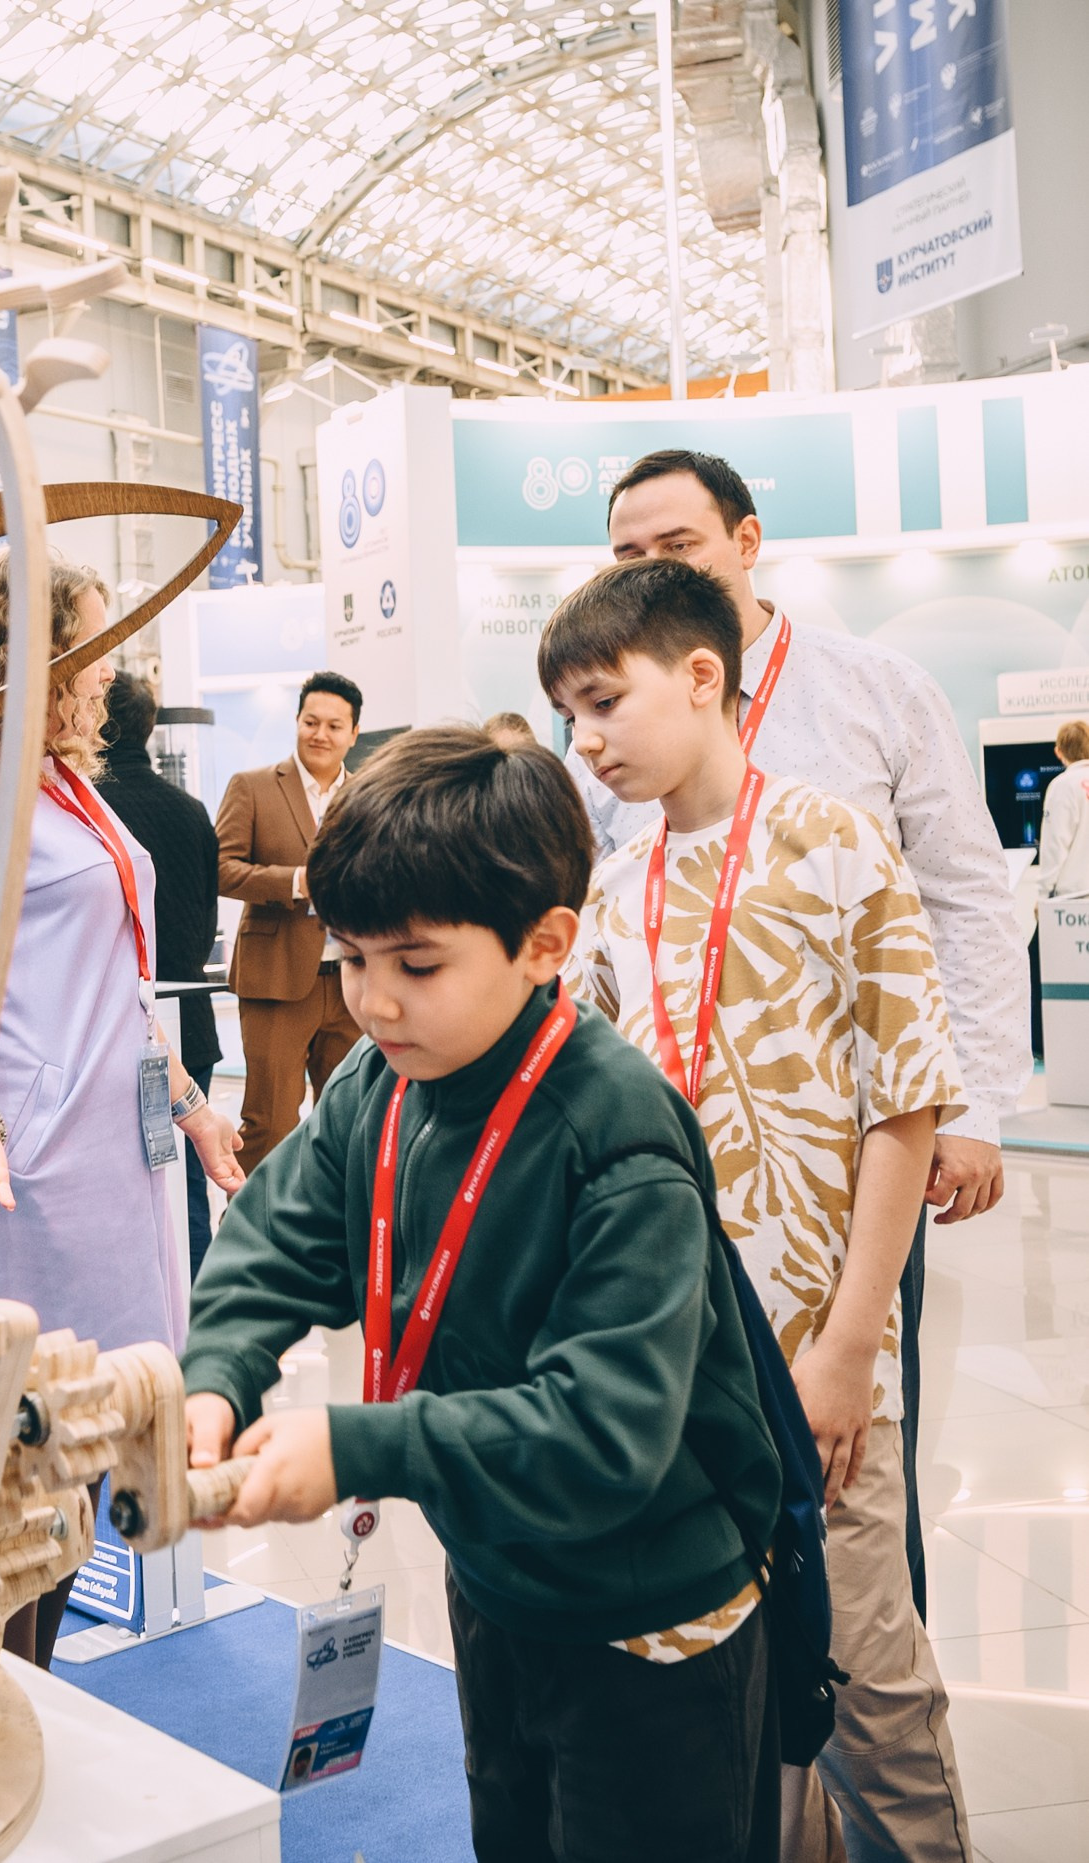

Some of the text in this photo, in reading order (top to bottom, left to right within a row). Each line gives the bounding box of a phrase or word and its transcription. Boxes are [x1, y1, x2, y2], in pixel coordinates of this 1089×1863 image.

[897, 211, 994, 267] КУРЧАТОВСКИЙ
[897, 251, 957, 289] ИНСТИТУТ
[522, 456, 630, 511] 80 ЛЕТ
[1048, 563, 1089, 583] АТО
[480, 593, 542, 608] МАЛАЯ
[1005, 691, 1089, 708] ЖИДКОСОЛЕ
[1054, 909, 1089, 927] Ток
[526, 1016, 566, 1075] ROSCONGRESS
